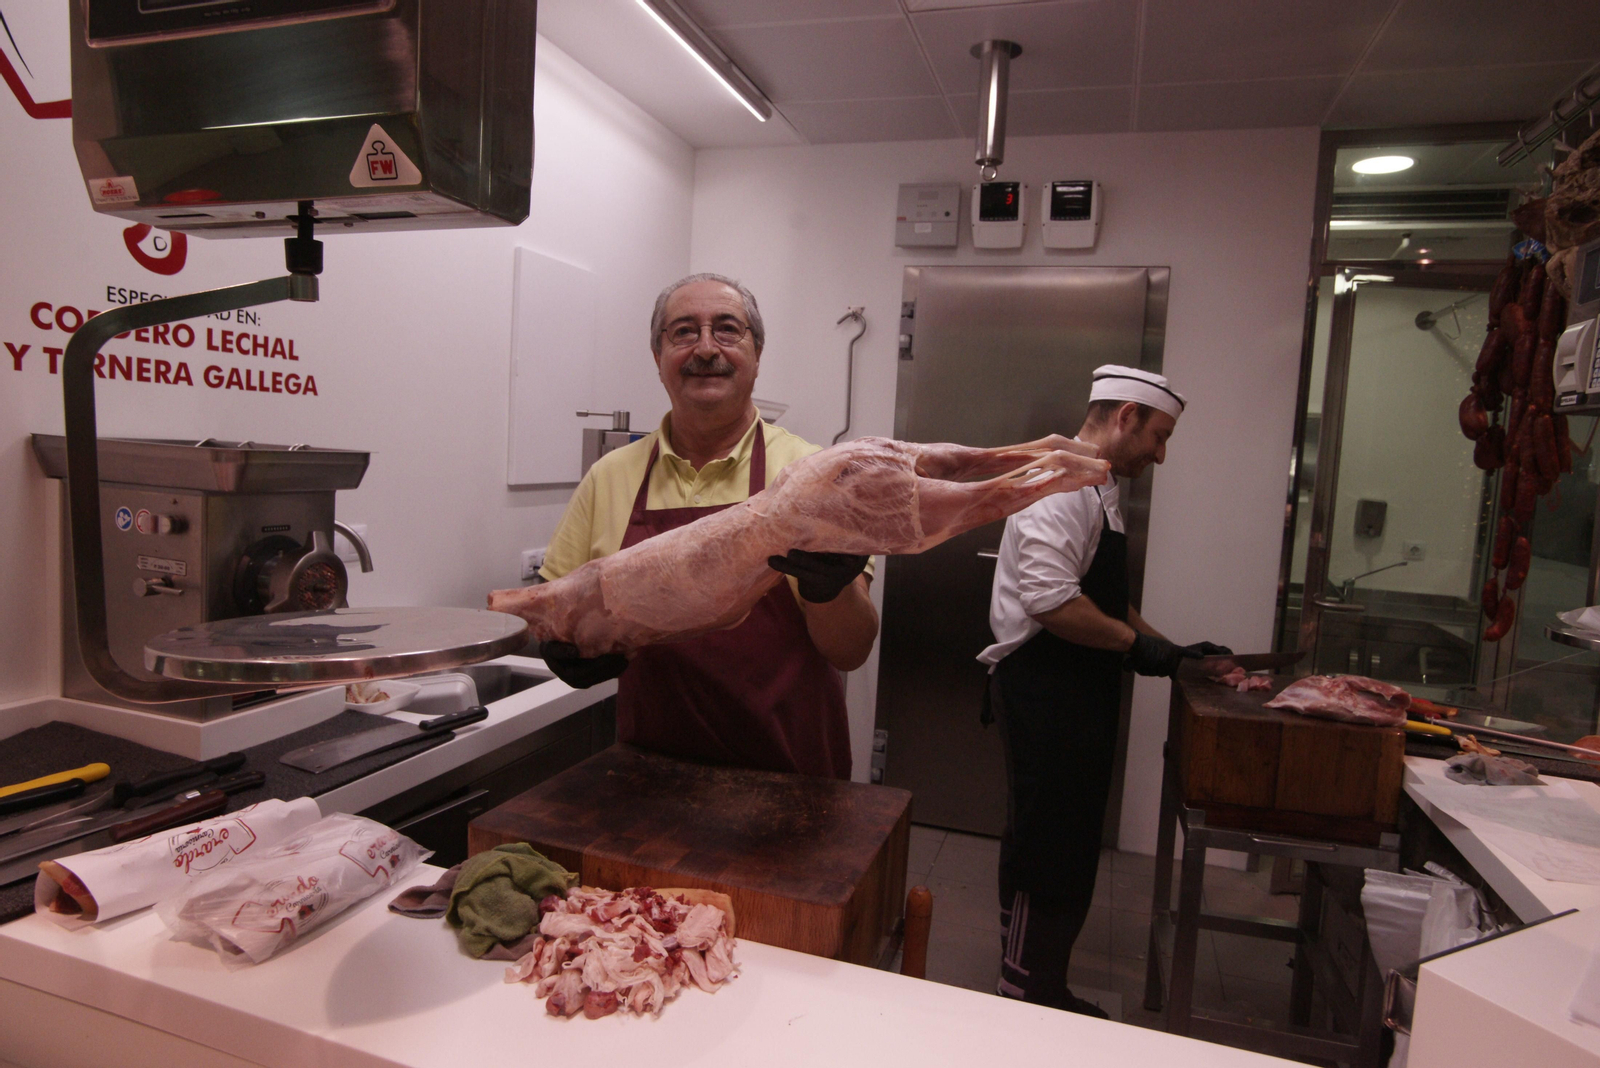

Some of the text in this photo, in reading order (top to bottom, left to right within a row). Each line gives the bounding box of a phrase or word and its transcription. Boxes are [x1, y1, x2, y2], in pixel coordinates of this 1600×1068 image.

[370, 160, 393, 175] FW
[1006, 193, 1013, 205] 3
[237, 309, 261, 327] EN:
[30, 302, 299, 361] COERO LECHAL
[3, 341, 318, 396] Y TRNERA GALLEGA
